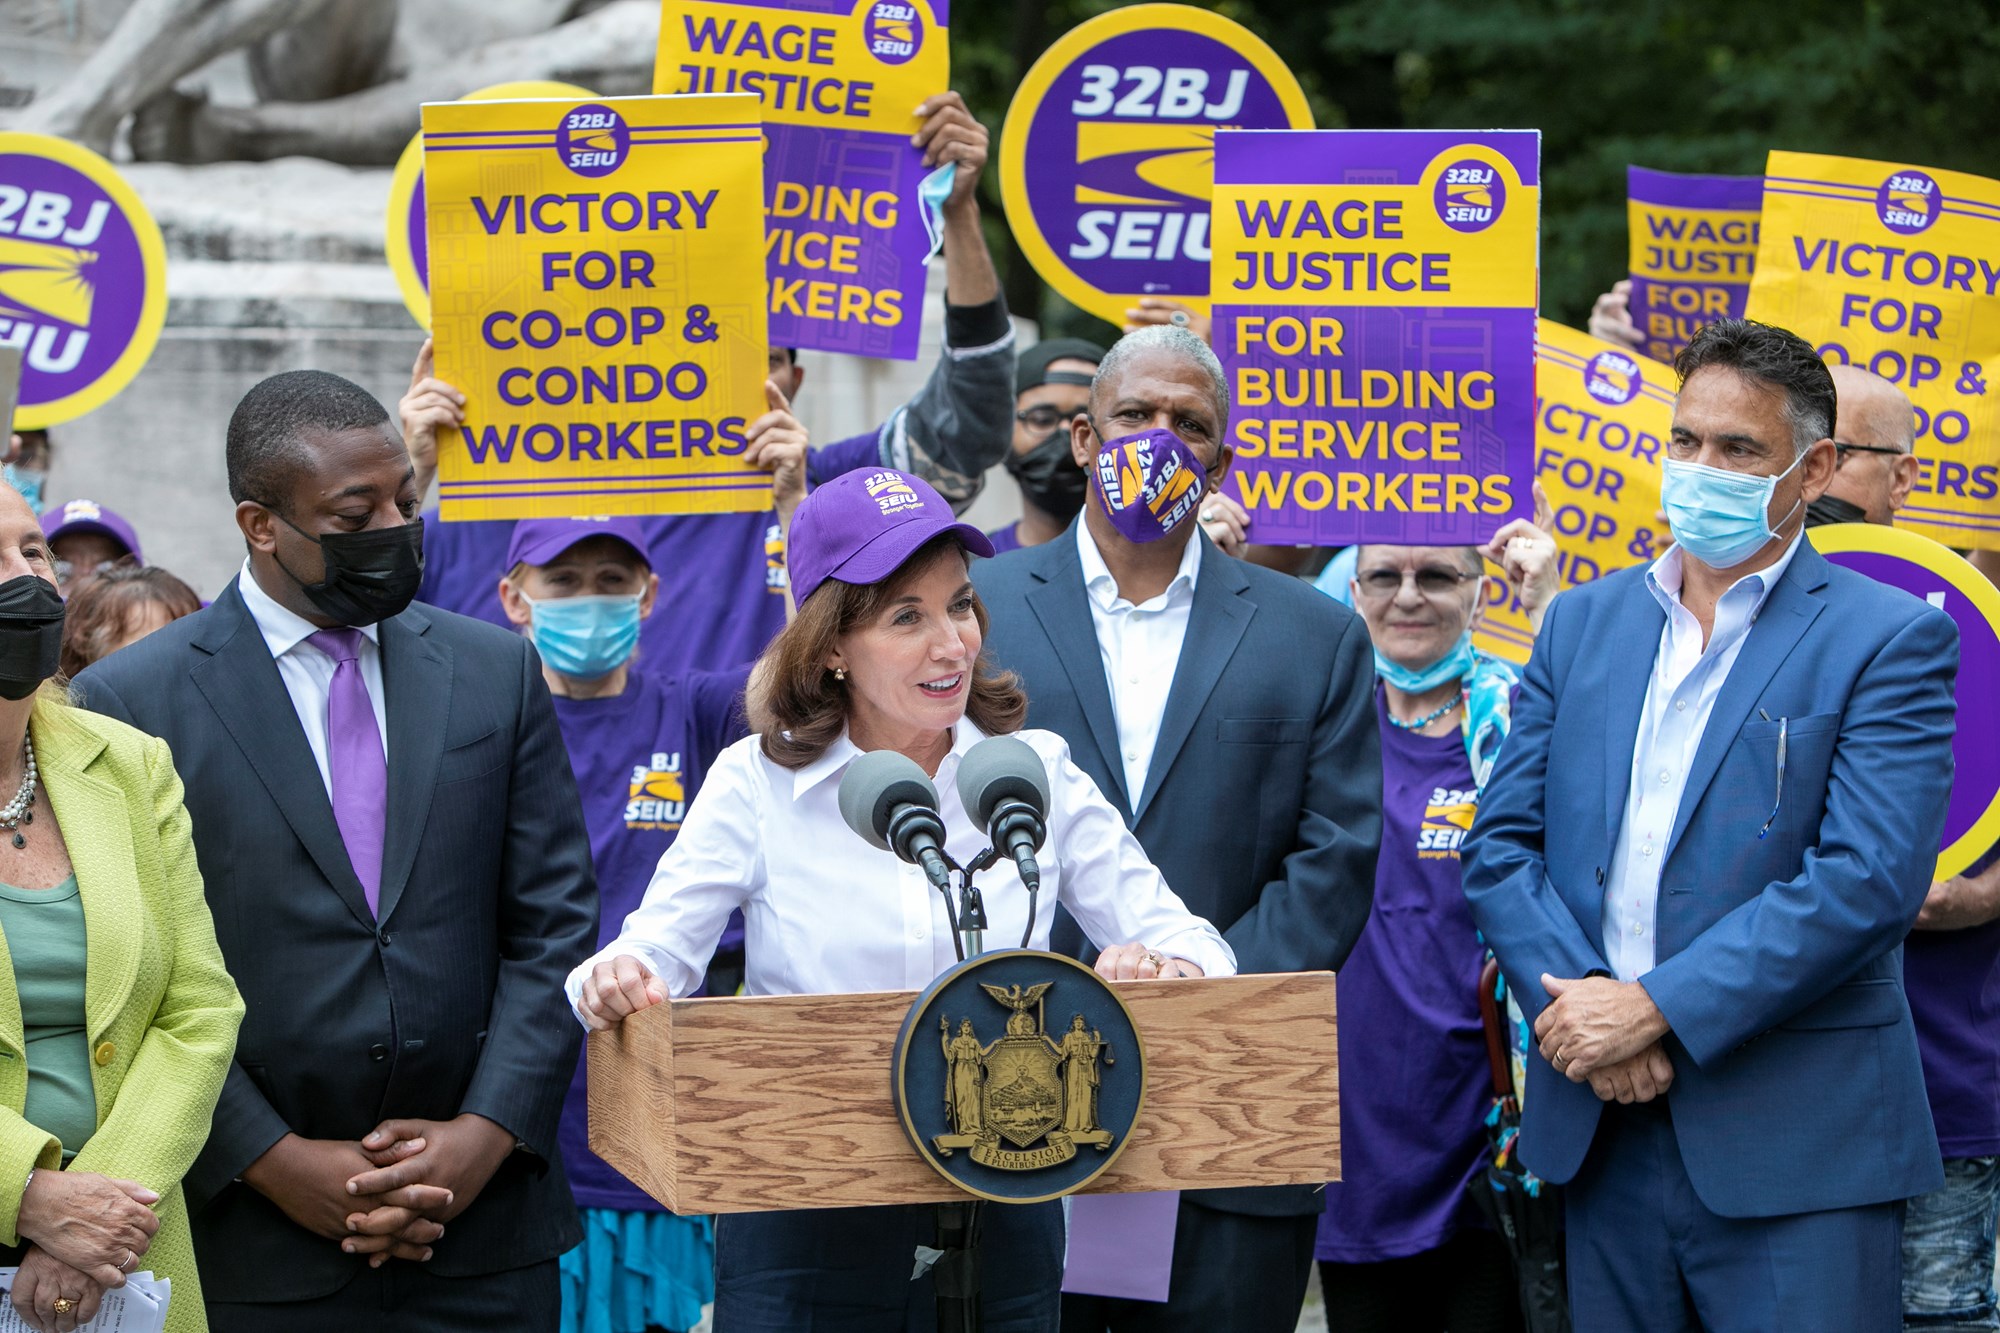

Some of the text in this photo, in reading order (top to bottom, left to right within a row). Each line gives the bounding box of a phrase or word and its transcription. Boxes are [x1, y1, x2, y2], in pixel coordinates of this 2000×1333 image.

[873, 3, 915, 21] 32BJ
[683, 14, 836, 65] WAGE
[871, 40, 914, 57] SEIU
[675, 64, 875, 117] JUSTICE
[1071, 64, 1250, 120] 32BJ
[566, 113, 617, 129] 32BJ
[568, 152, 618, 168] SEIU
[1445, 168, 1494, 184] 32BJ
[1888, 176, 1934, 195] 32BJ
[0, 184, 112, 246] 2BJ
[470, 189, 720, 235] VICTORY
[1235, 200, 1404, 239] WAGE
[1445, 207, 1493, 222] SEIU
[1884, 209, 1929, 228] SEIU
[542, 250, 656, 292] FOR
[1232, 252, 1451, 292] JUSTICE
[1645, 246, 1755, 275] JUSTI
[1793, 235, 2000, 296] VICTORY
[766, 277, 904, 327] KERS
[1646, 283, 1731, 316] FOR
[1840, 293, 1940, 340] FOR
[482, 304, 720, 350] CO-OP &
[1236, 316, 1345, 356] FOR
[497, 362, 708, 406] CONDO
[1236, 368, 1496, 411] BUILDING
[1955, 361, 1988, 395] &
[461, 416, 750, 465] WORKERS
[1235, 419, 1463, 461] SERVICE
[864, 472, 903, 490] 32BJ
[1099, 452, 1125, 510] SEIU
[1145, 449, 1181, 505] 32BJ
[1235, 470, 1514, 515] WORKERS
[1536, 448, 1625, 502] FOR
[879, 493, 918, 510] SEIU
[1161, 478, 1202, 533] SEIU
[623, 800, 685, 822] SEIU
[983, 1152, 1067, 1169] E PLURIBUS UNUM
[985, 1145, 1064, 1162] EXCELSIOR
